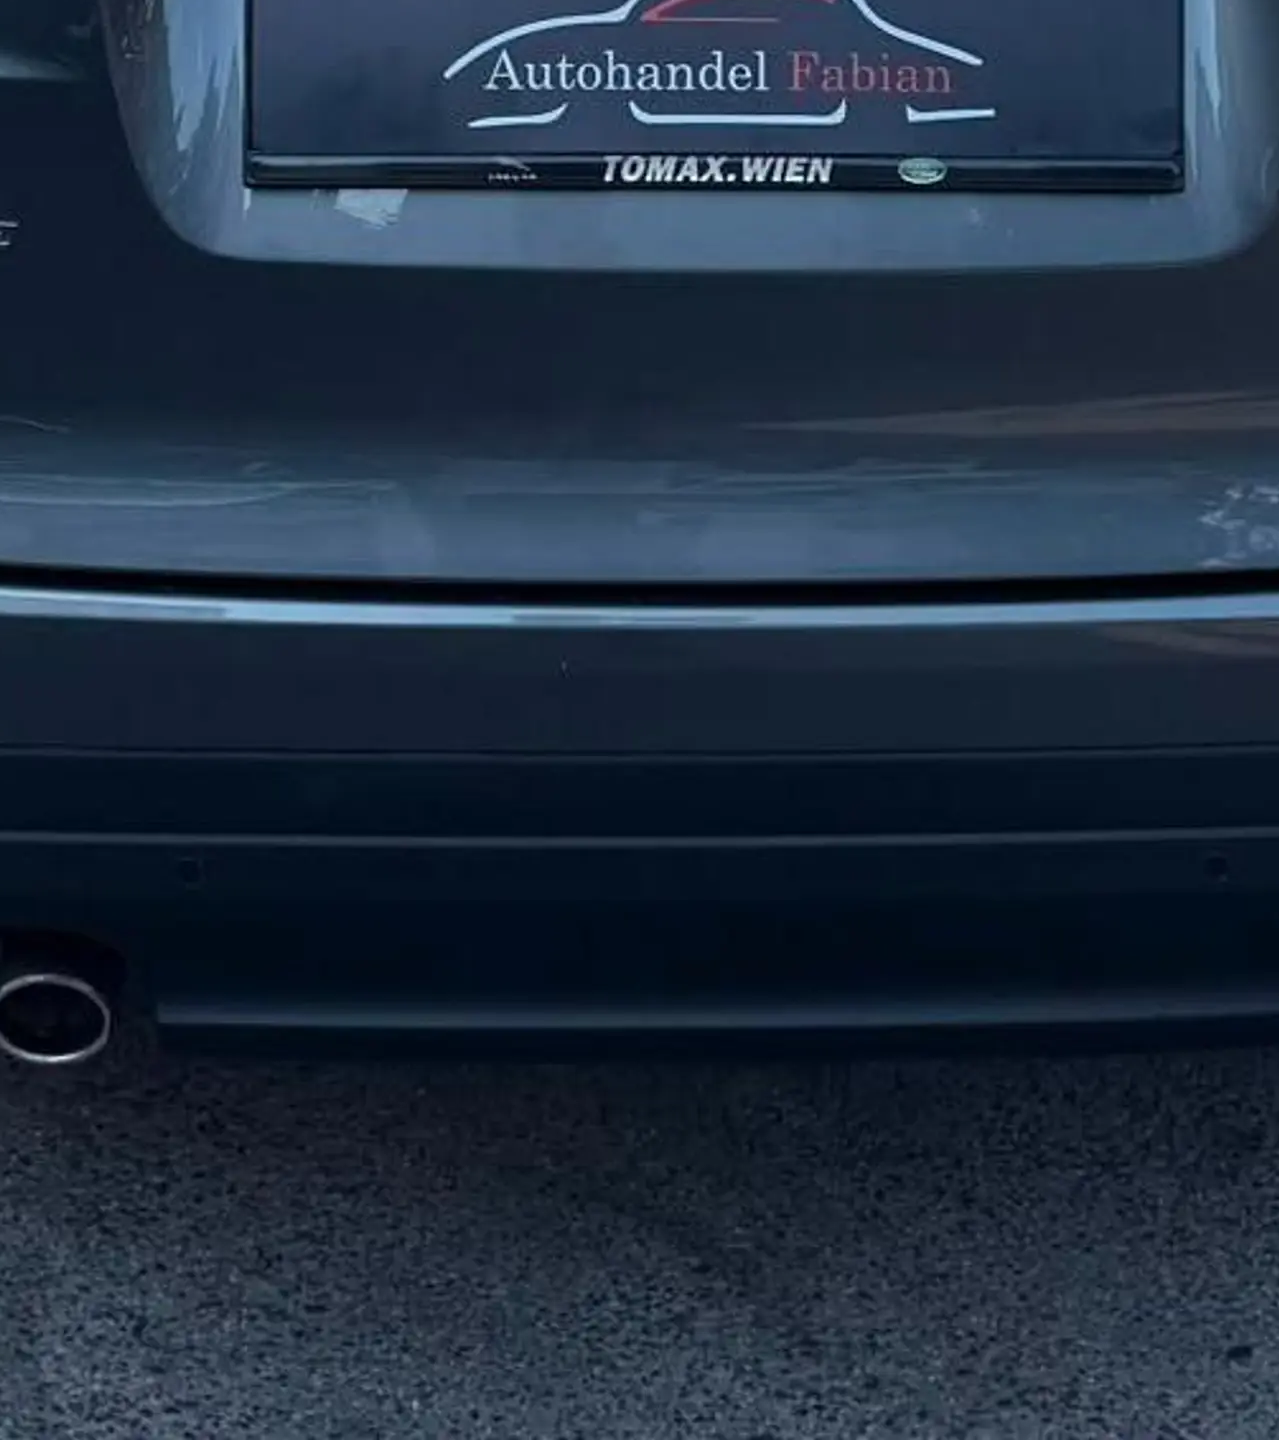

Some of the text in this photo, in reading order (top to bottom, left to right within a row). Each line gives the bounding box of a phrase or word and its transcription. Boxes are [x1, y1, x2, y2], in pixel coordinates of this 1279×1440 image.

[482, 49, 952, 94] Autohandel Fabian
[602, 155, 834, 184] TOMAX.WIEN
